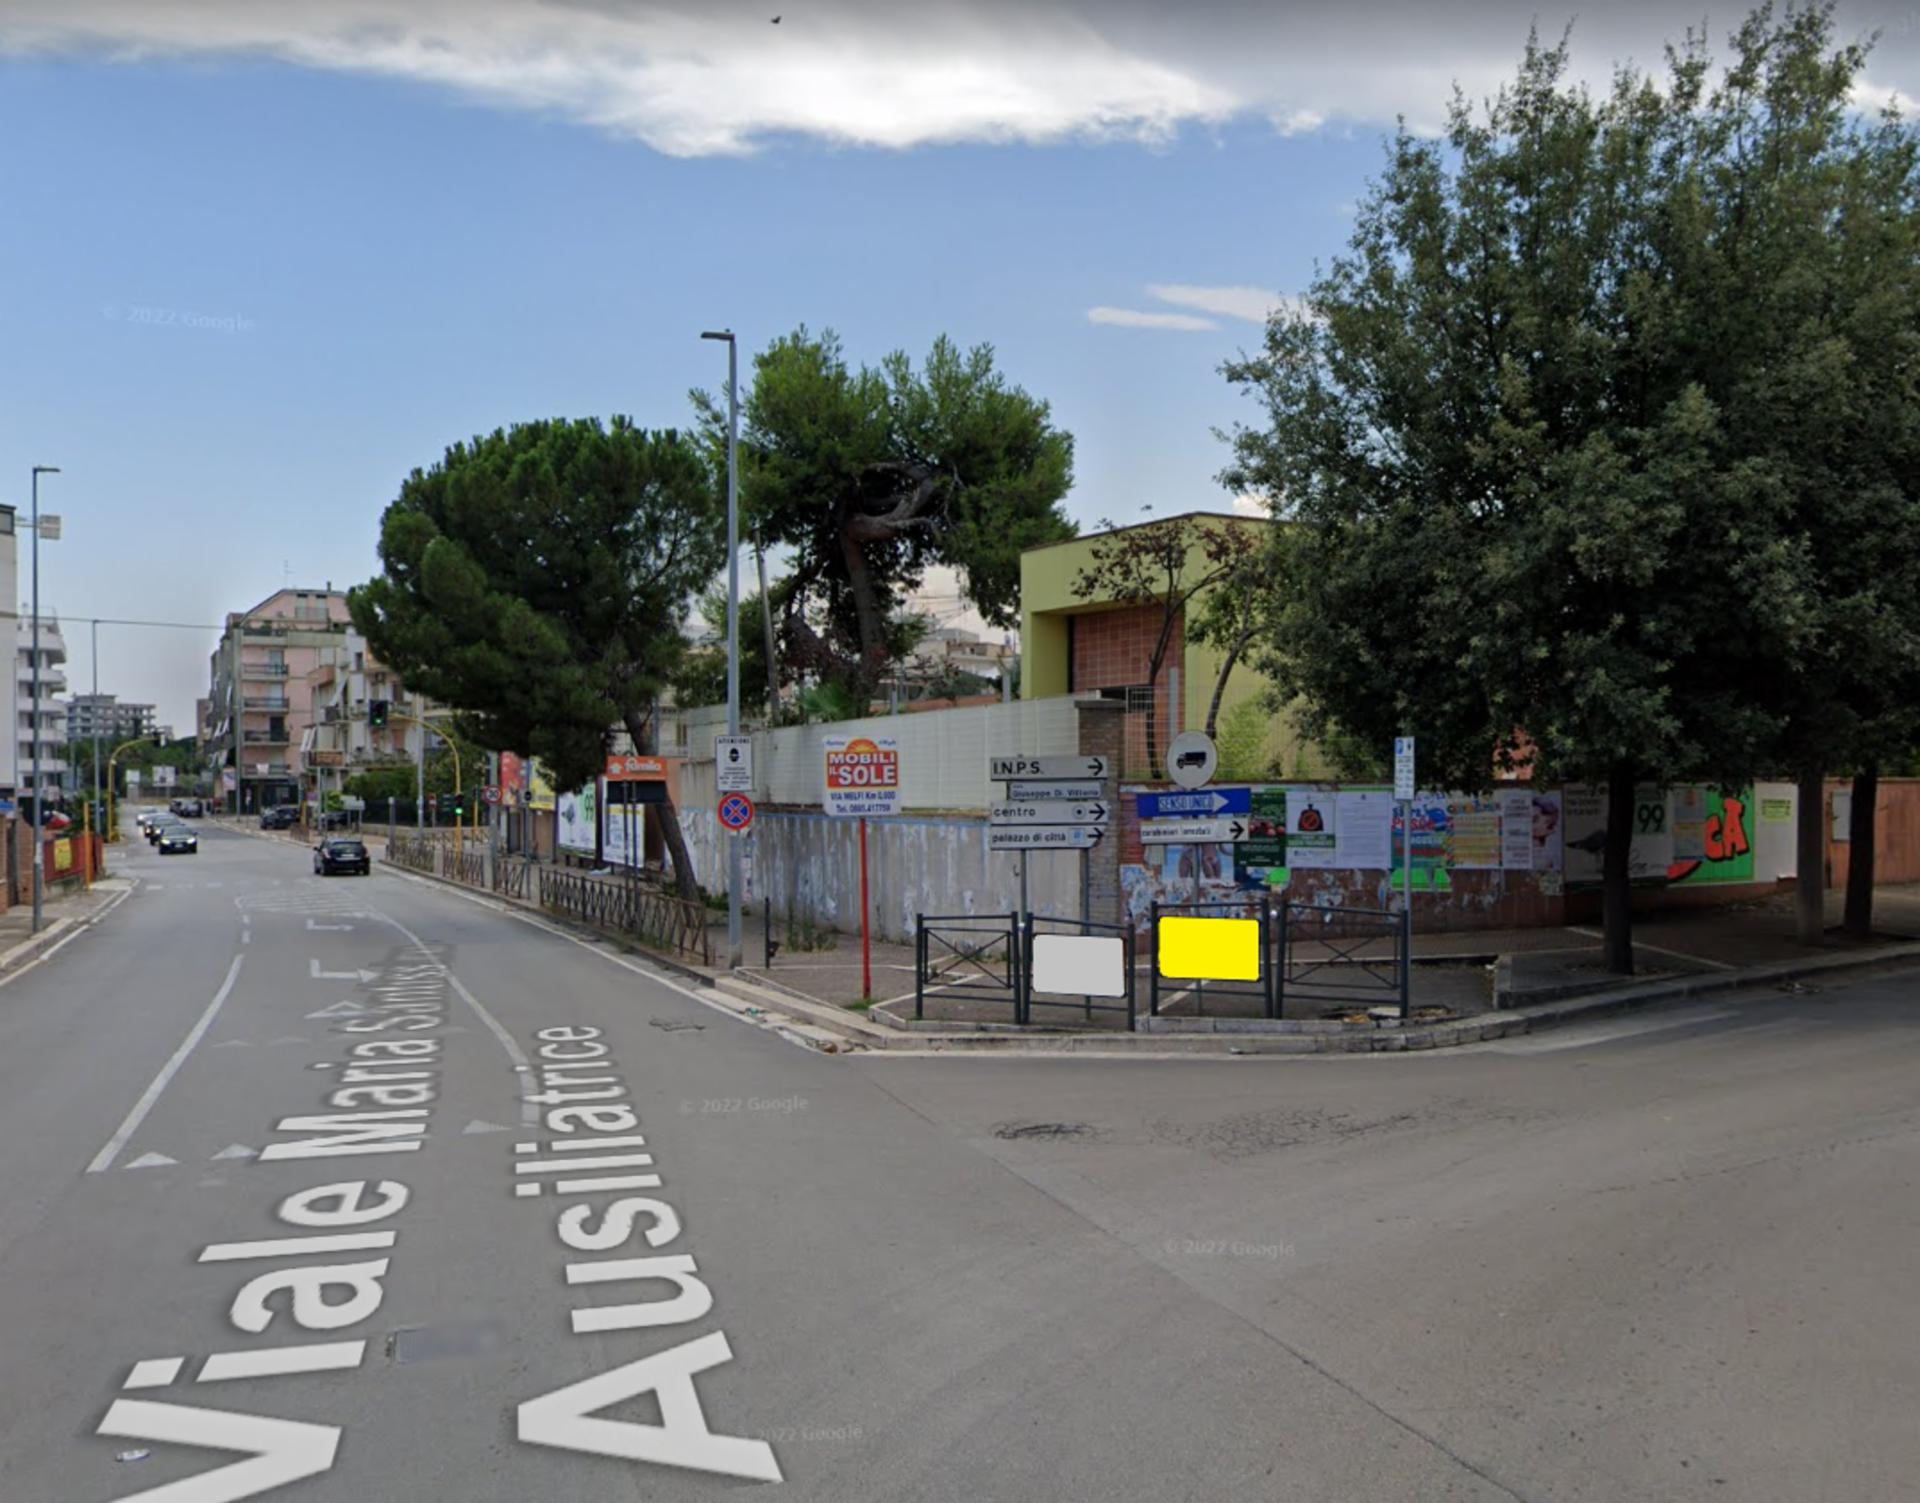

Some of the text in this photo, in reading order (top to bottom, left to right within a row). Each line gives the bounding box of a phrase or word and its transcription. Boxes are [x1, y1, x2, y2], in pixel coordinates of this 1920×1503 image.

[828, 752, 896, 765] MOBILI
[828, 765, 897, 785] IL SOLE
[993, 761, 1044, 775] I.N.P.S.
[1159, 795, 1214, 810] SENSO UNICO
[993, 806, 1036, 817] centro
[1637, 803, 1665, 832] 99
[992, 831, 1066, 843] palazzo di città
